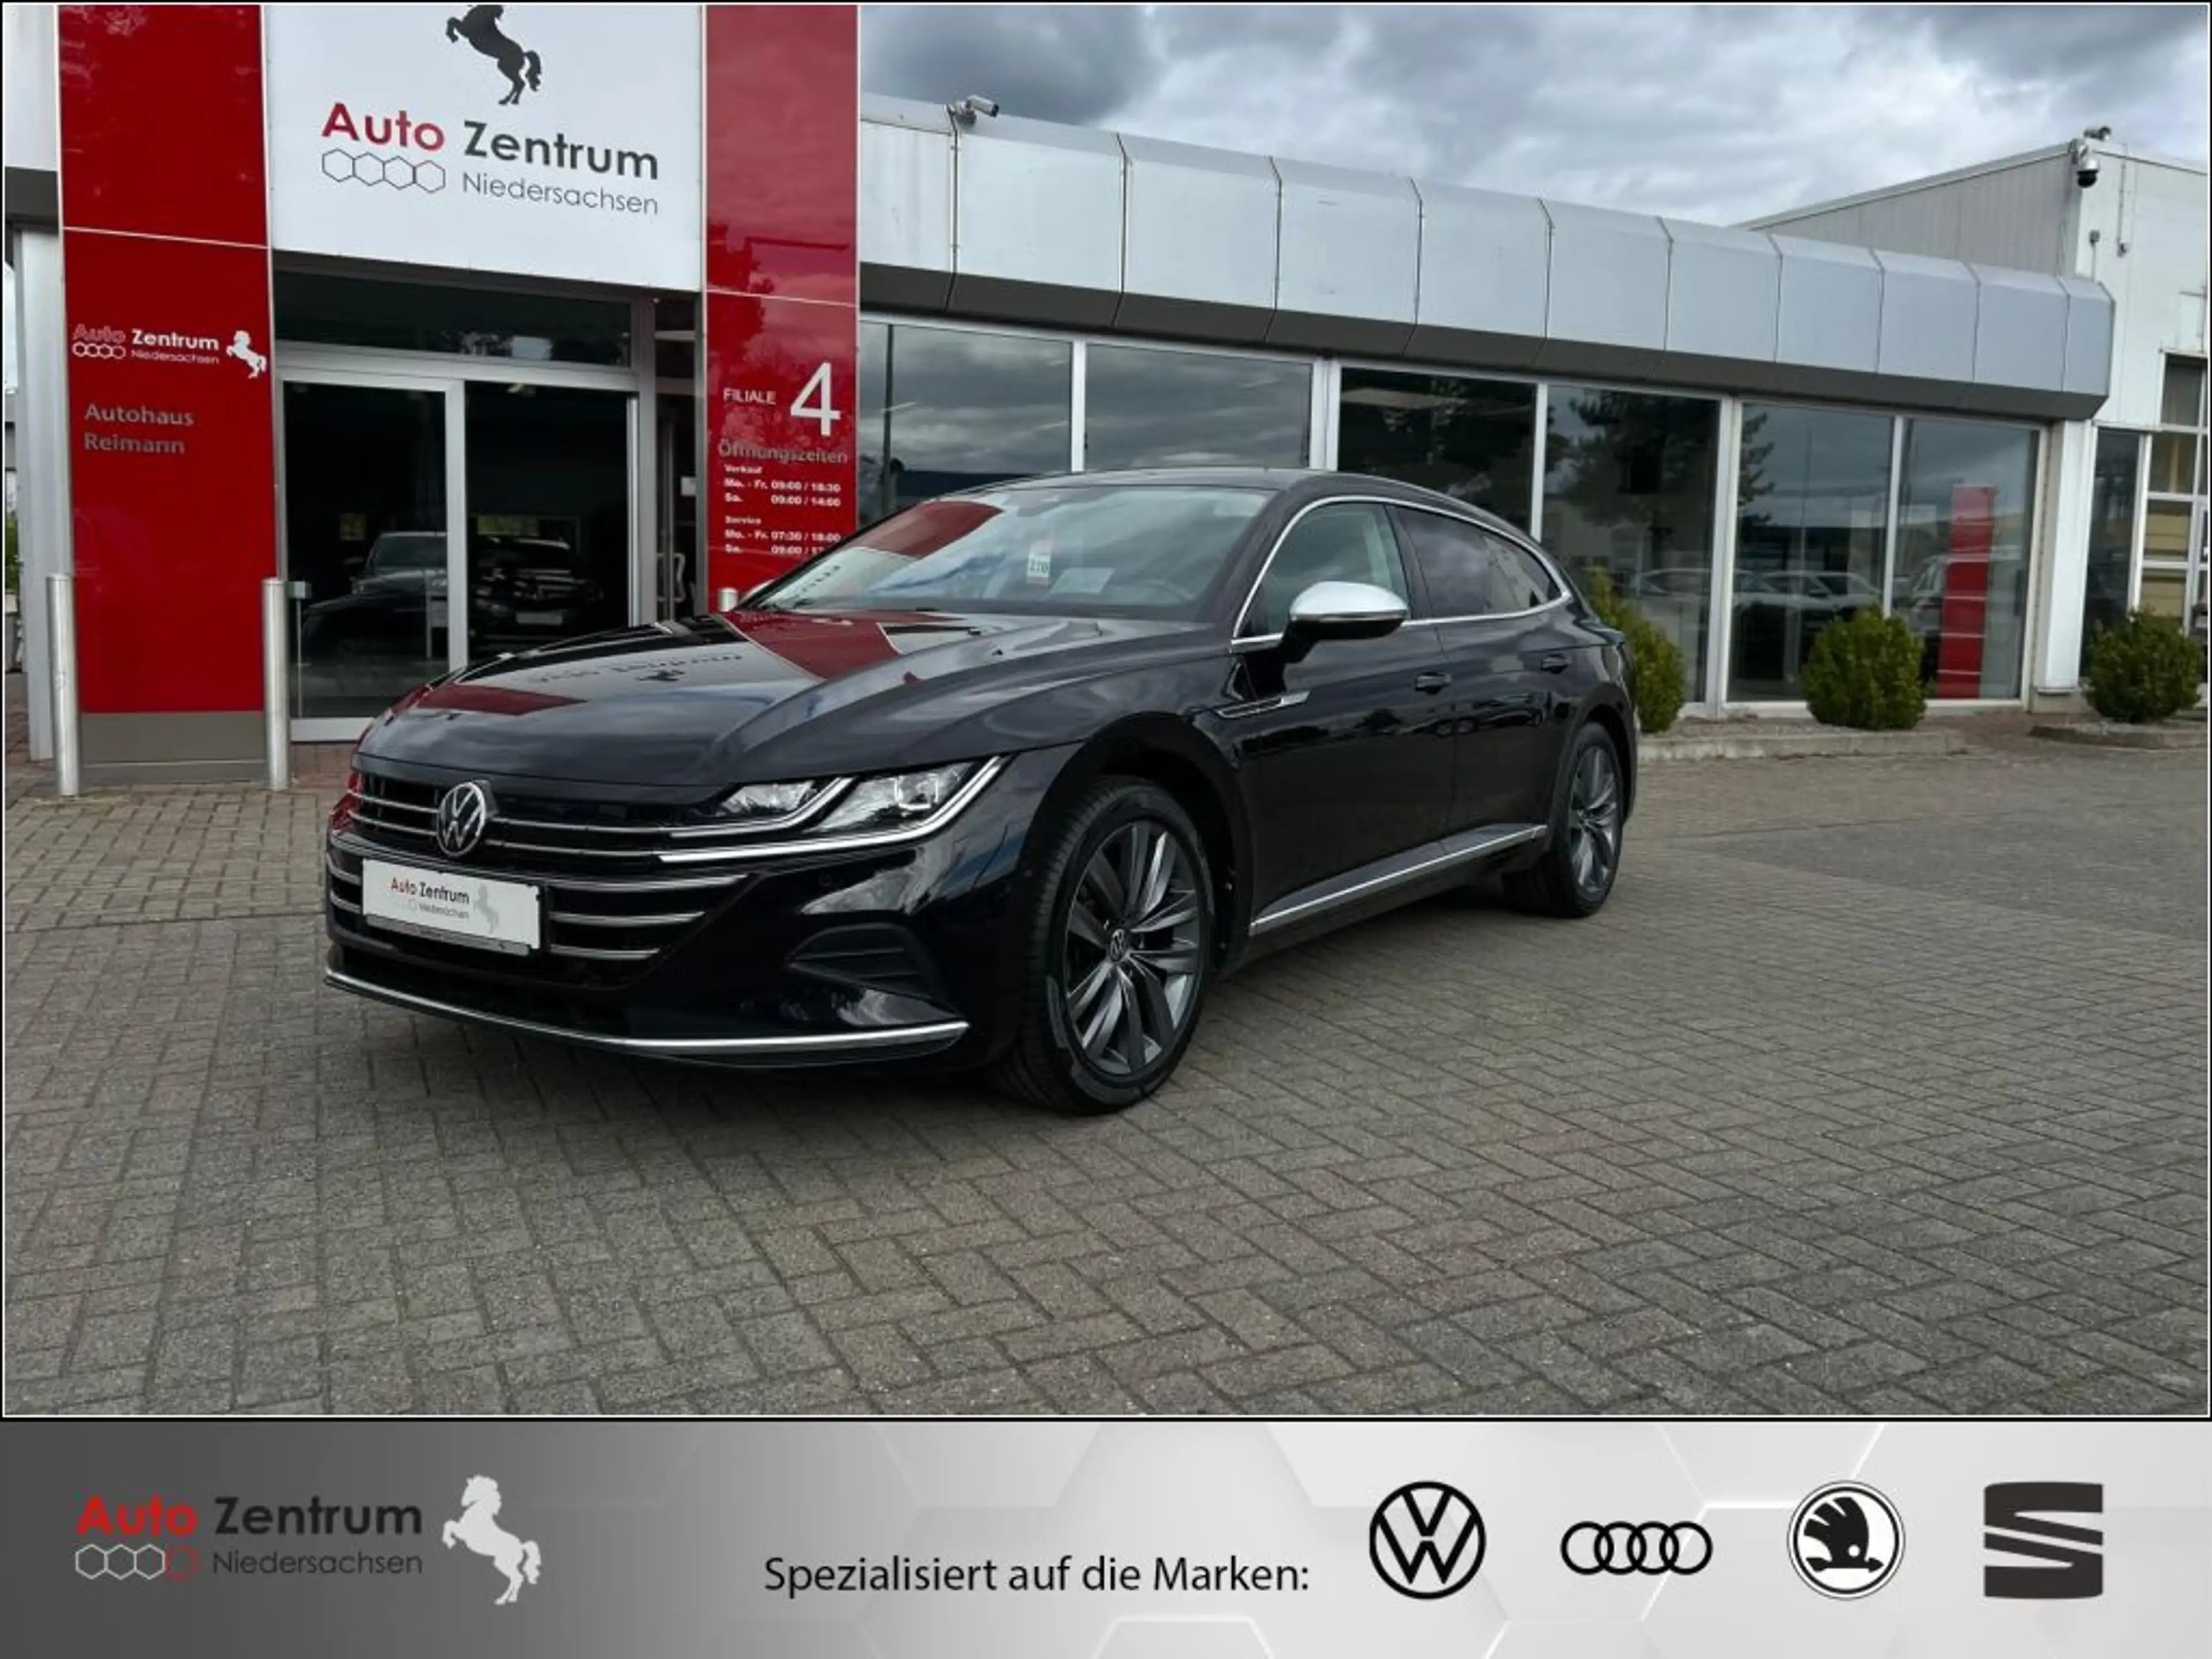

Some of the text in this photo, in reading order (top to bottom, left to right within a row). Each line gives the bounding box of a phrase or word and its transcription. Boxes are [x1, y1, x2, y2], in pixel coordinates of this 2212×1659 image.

[321, 103, 658, 180] Auto Zentrum
[462, 172, 658, 215] Niedersachsen
[73, 323, 219, 350] Auto Zentrum
[131, 350, 219, 364] Niedersachsen
[723, 362, 841, 437] FILIALE 4
[84, 404, 194, 426] Autohaus
[84, 432, 184, 454] Reimann
[391, 877, 469, 904] Auto Zentrum
